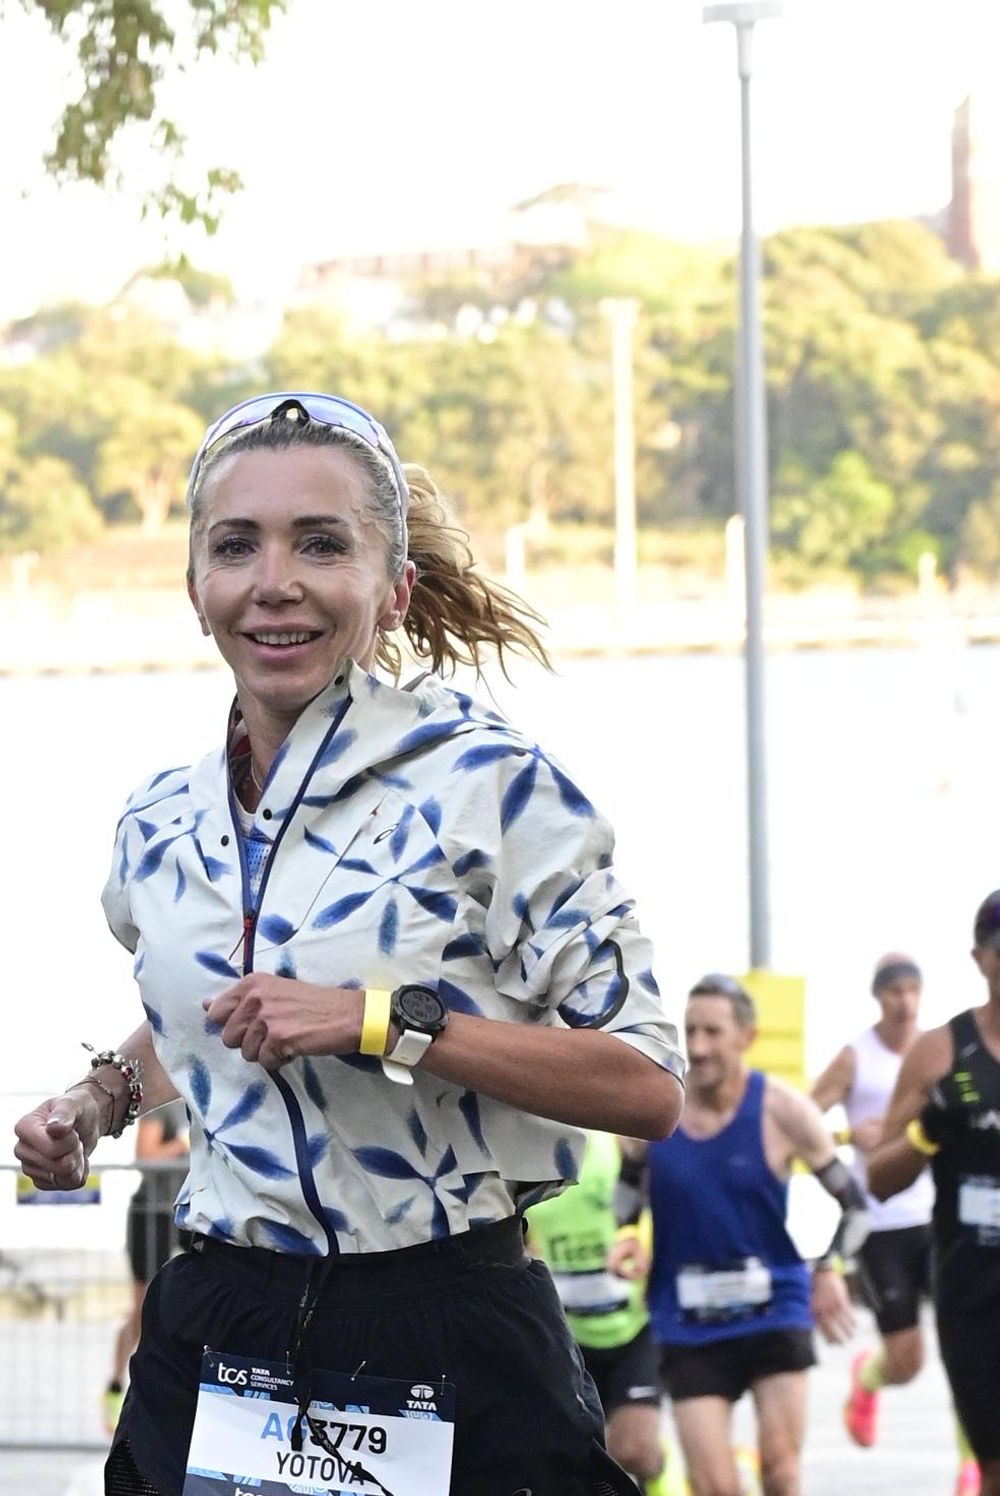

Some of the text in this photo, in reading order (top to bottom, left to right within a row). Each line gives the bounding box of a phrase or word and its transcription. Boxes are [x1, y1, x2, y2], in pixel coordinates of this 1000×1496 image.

[217, 1362, 248, 1385] tcs
[251, 1367, 270, 1376] TATA
[250, 1374, 294, 1386] CONSULTANCY
[250, 1381, 278, 1391] SERVICES
[406, 1399, 437, 1411] TATA
[277, 1451, 364, 1485] YOTOVA
